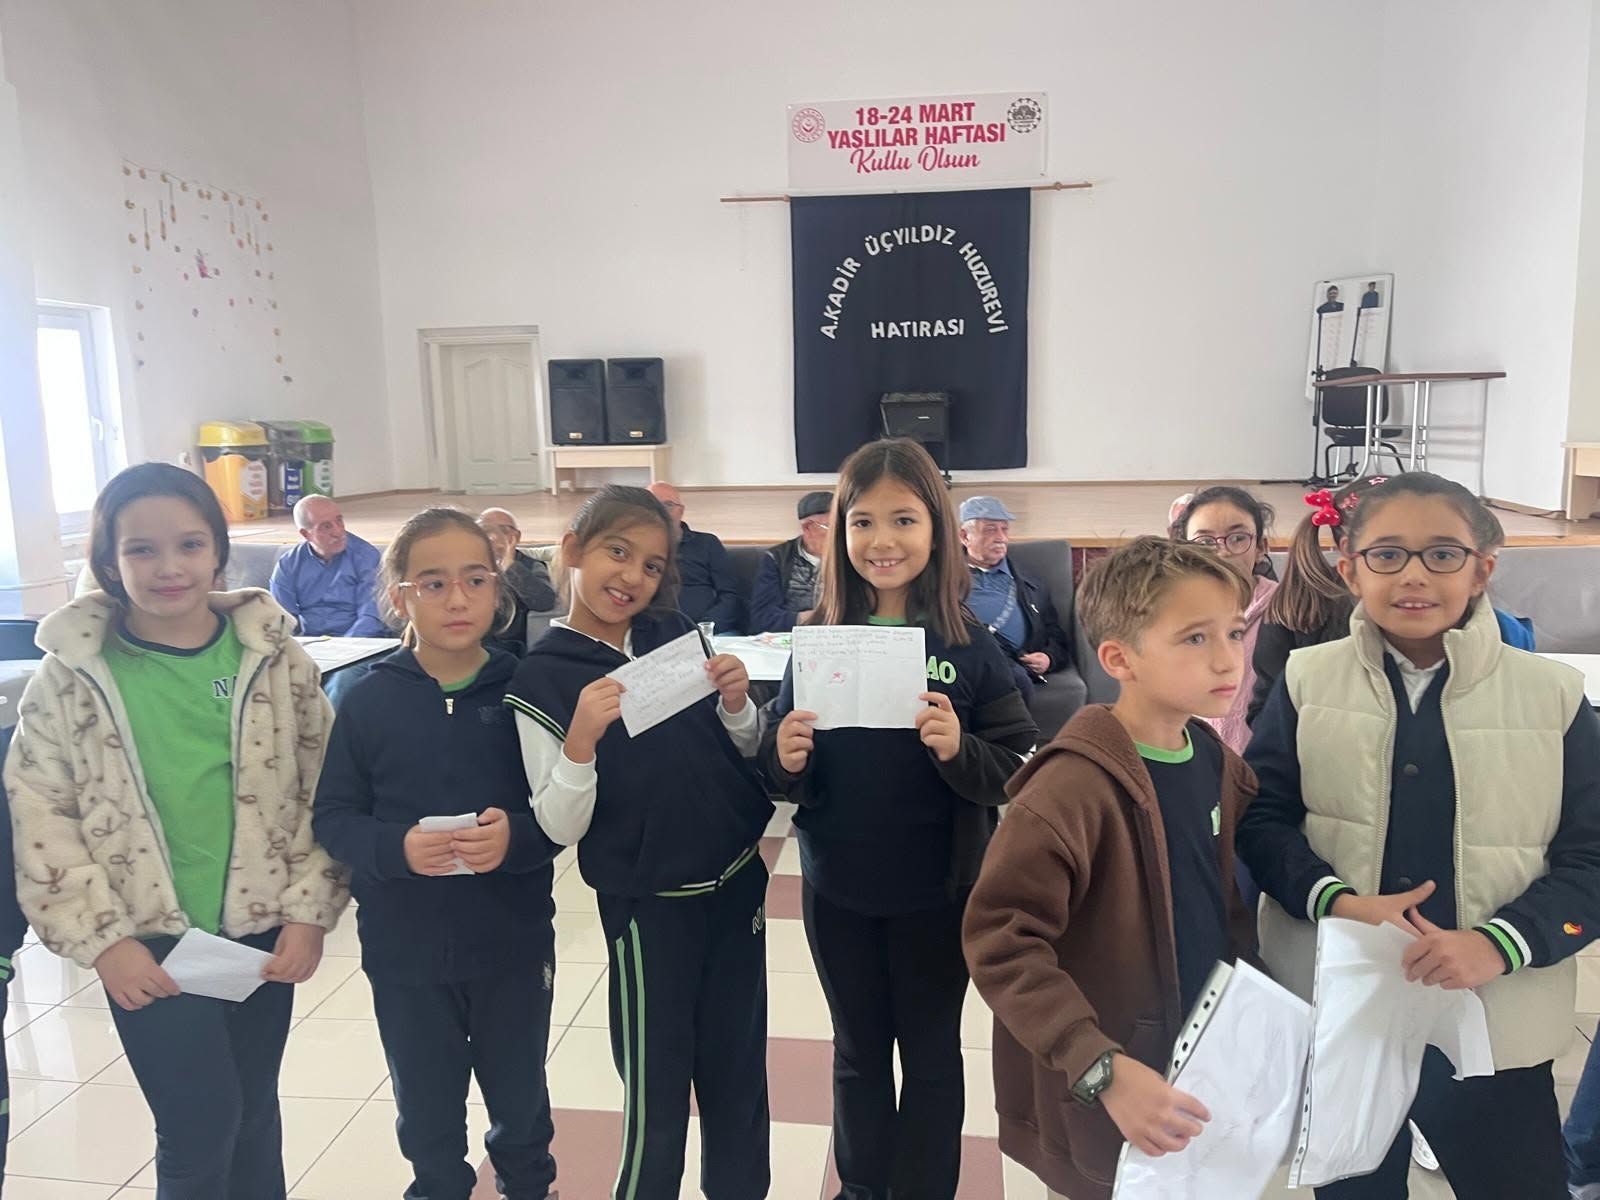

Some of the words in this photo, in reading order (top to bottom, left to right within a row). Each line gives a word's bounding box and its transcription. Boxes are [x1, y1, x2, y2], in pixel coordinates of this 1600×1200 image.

[855, 105, 913, 126] 18-24
[919, 102, 976, 123] MART
[827, 127, 918, 149] YAŞLILAR
[925, 123, 1006, 145] HAFTASI
[918, 145, 980, 172] Olsun
[820, 257, 861, 339] A.KADİR
[865, 225, 956, 256] ÜÇYILDIZ
[959, 242, 1009, 333] HUZUREVİ
[871, 319, 965, 338] HATIRASI
